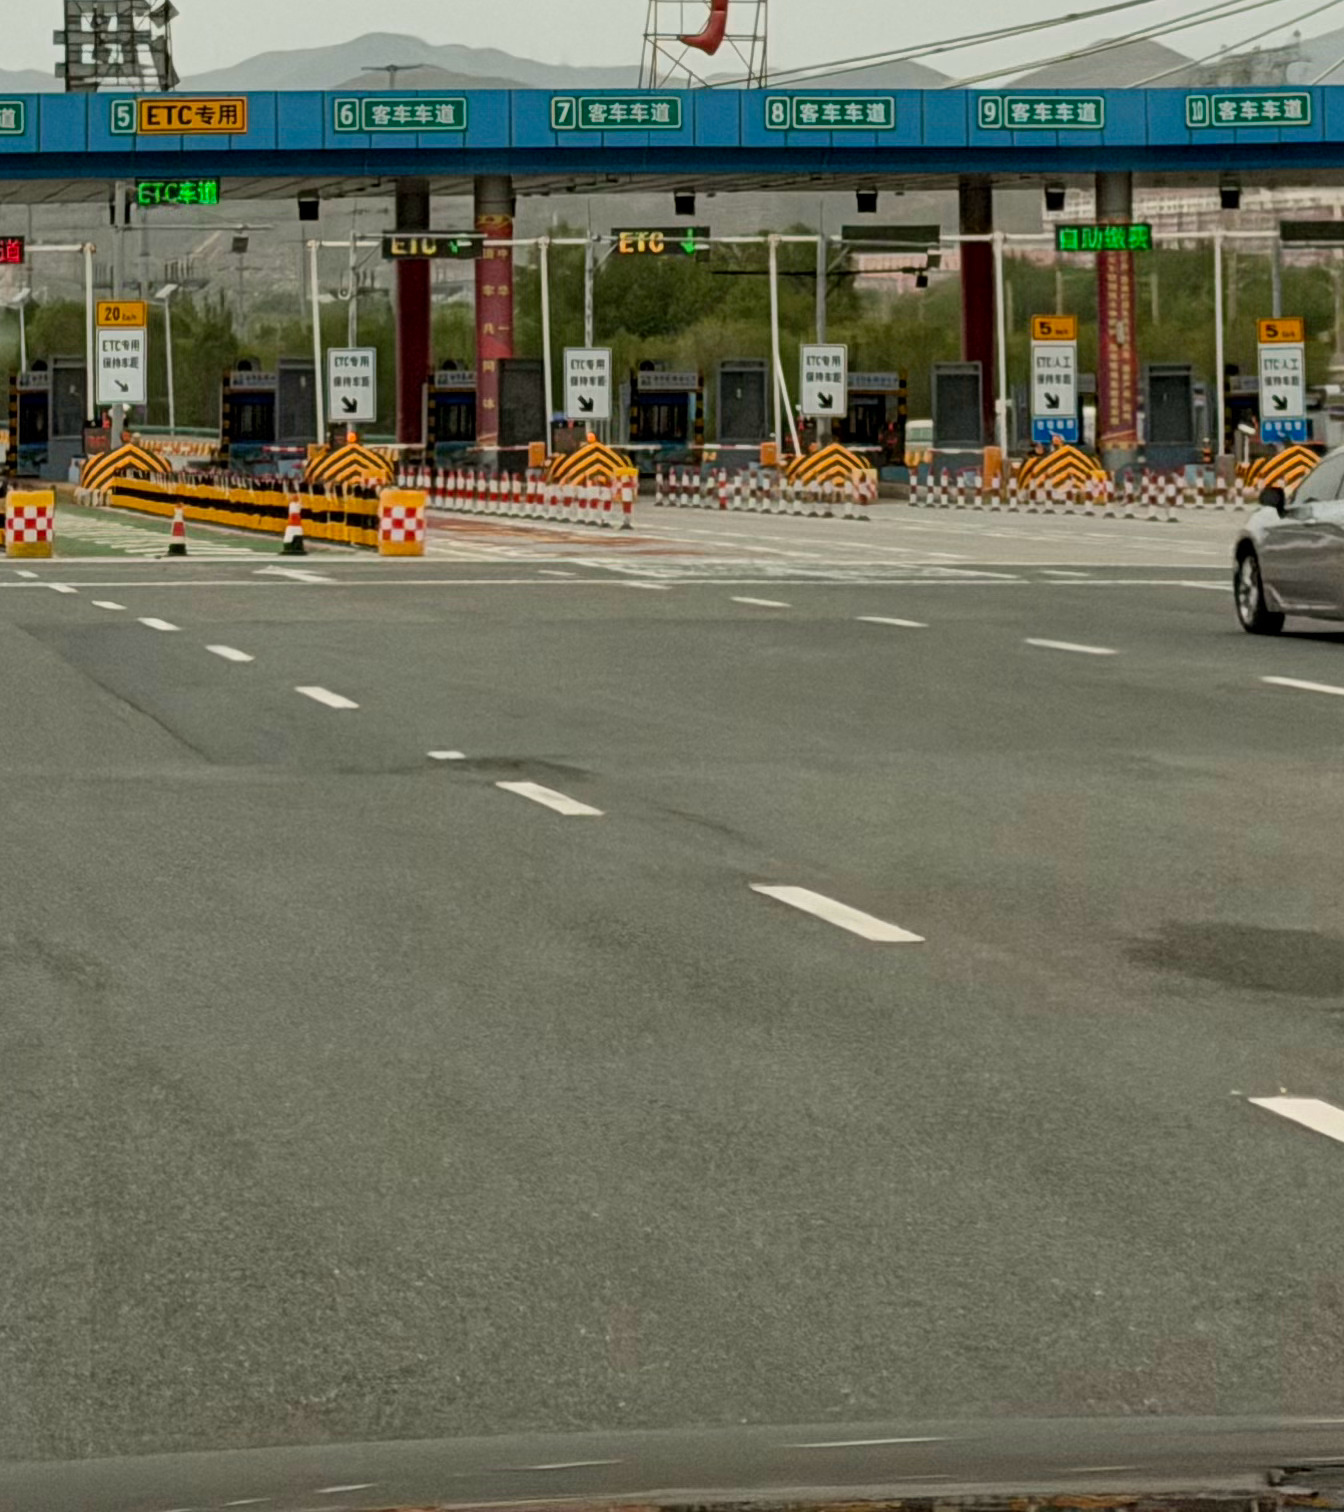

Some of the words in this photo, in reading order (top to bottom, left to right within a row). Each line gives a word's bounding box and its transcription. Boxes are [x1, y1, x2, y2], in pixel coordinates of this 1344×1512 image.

[116, 105, 131, 127] 5
[146, 104, 239, 127] ETC专用
[339, 104, 353, 126] 6
[371, 104, 456, 126] 客车车道
[557, 103, 571, 123] 7
[587, 102, 671, 124] 客车车道
[771, 102, 785, 123] 8
[799, 102, 886, 124] 客车车道
[983, 101, 997, 123] 9
[1010, 101, 1097, 124] 客车车道
[1191, 100, 1204, 122] 10
[1217, 98, 1304, 121] 客车车道
[137, 181, 219, 206] ETC车道
[390, 235, 438, 256] ETC
[618, 230, 665, 254] ETC
[104, 305, 121, 322] 20
[1038, 321, 1053, 336] 5
[1264, 323, 1279, 339] 5
